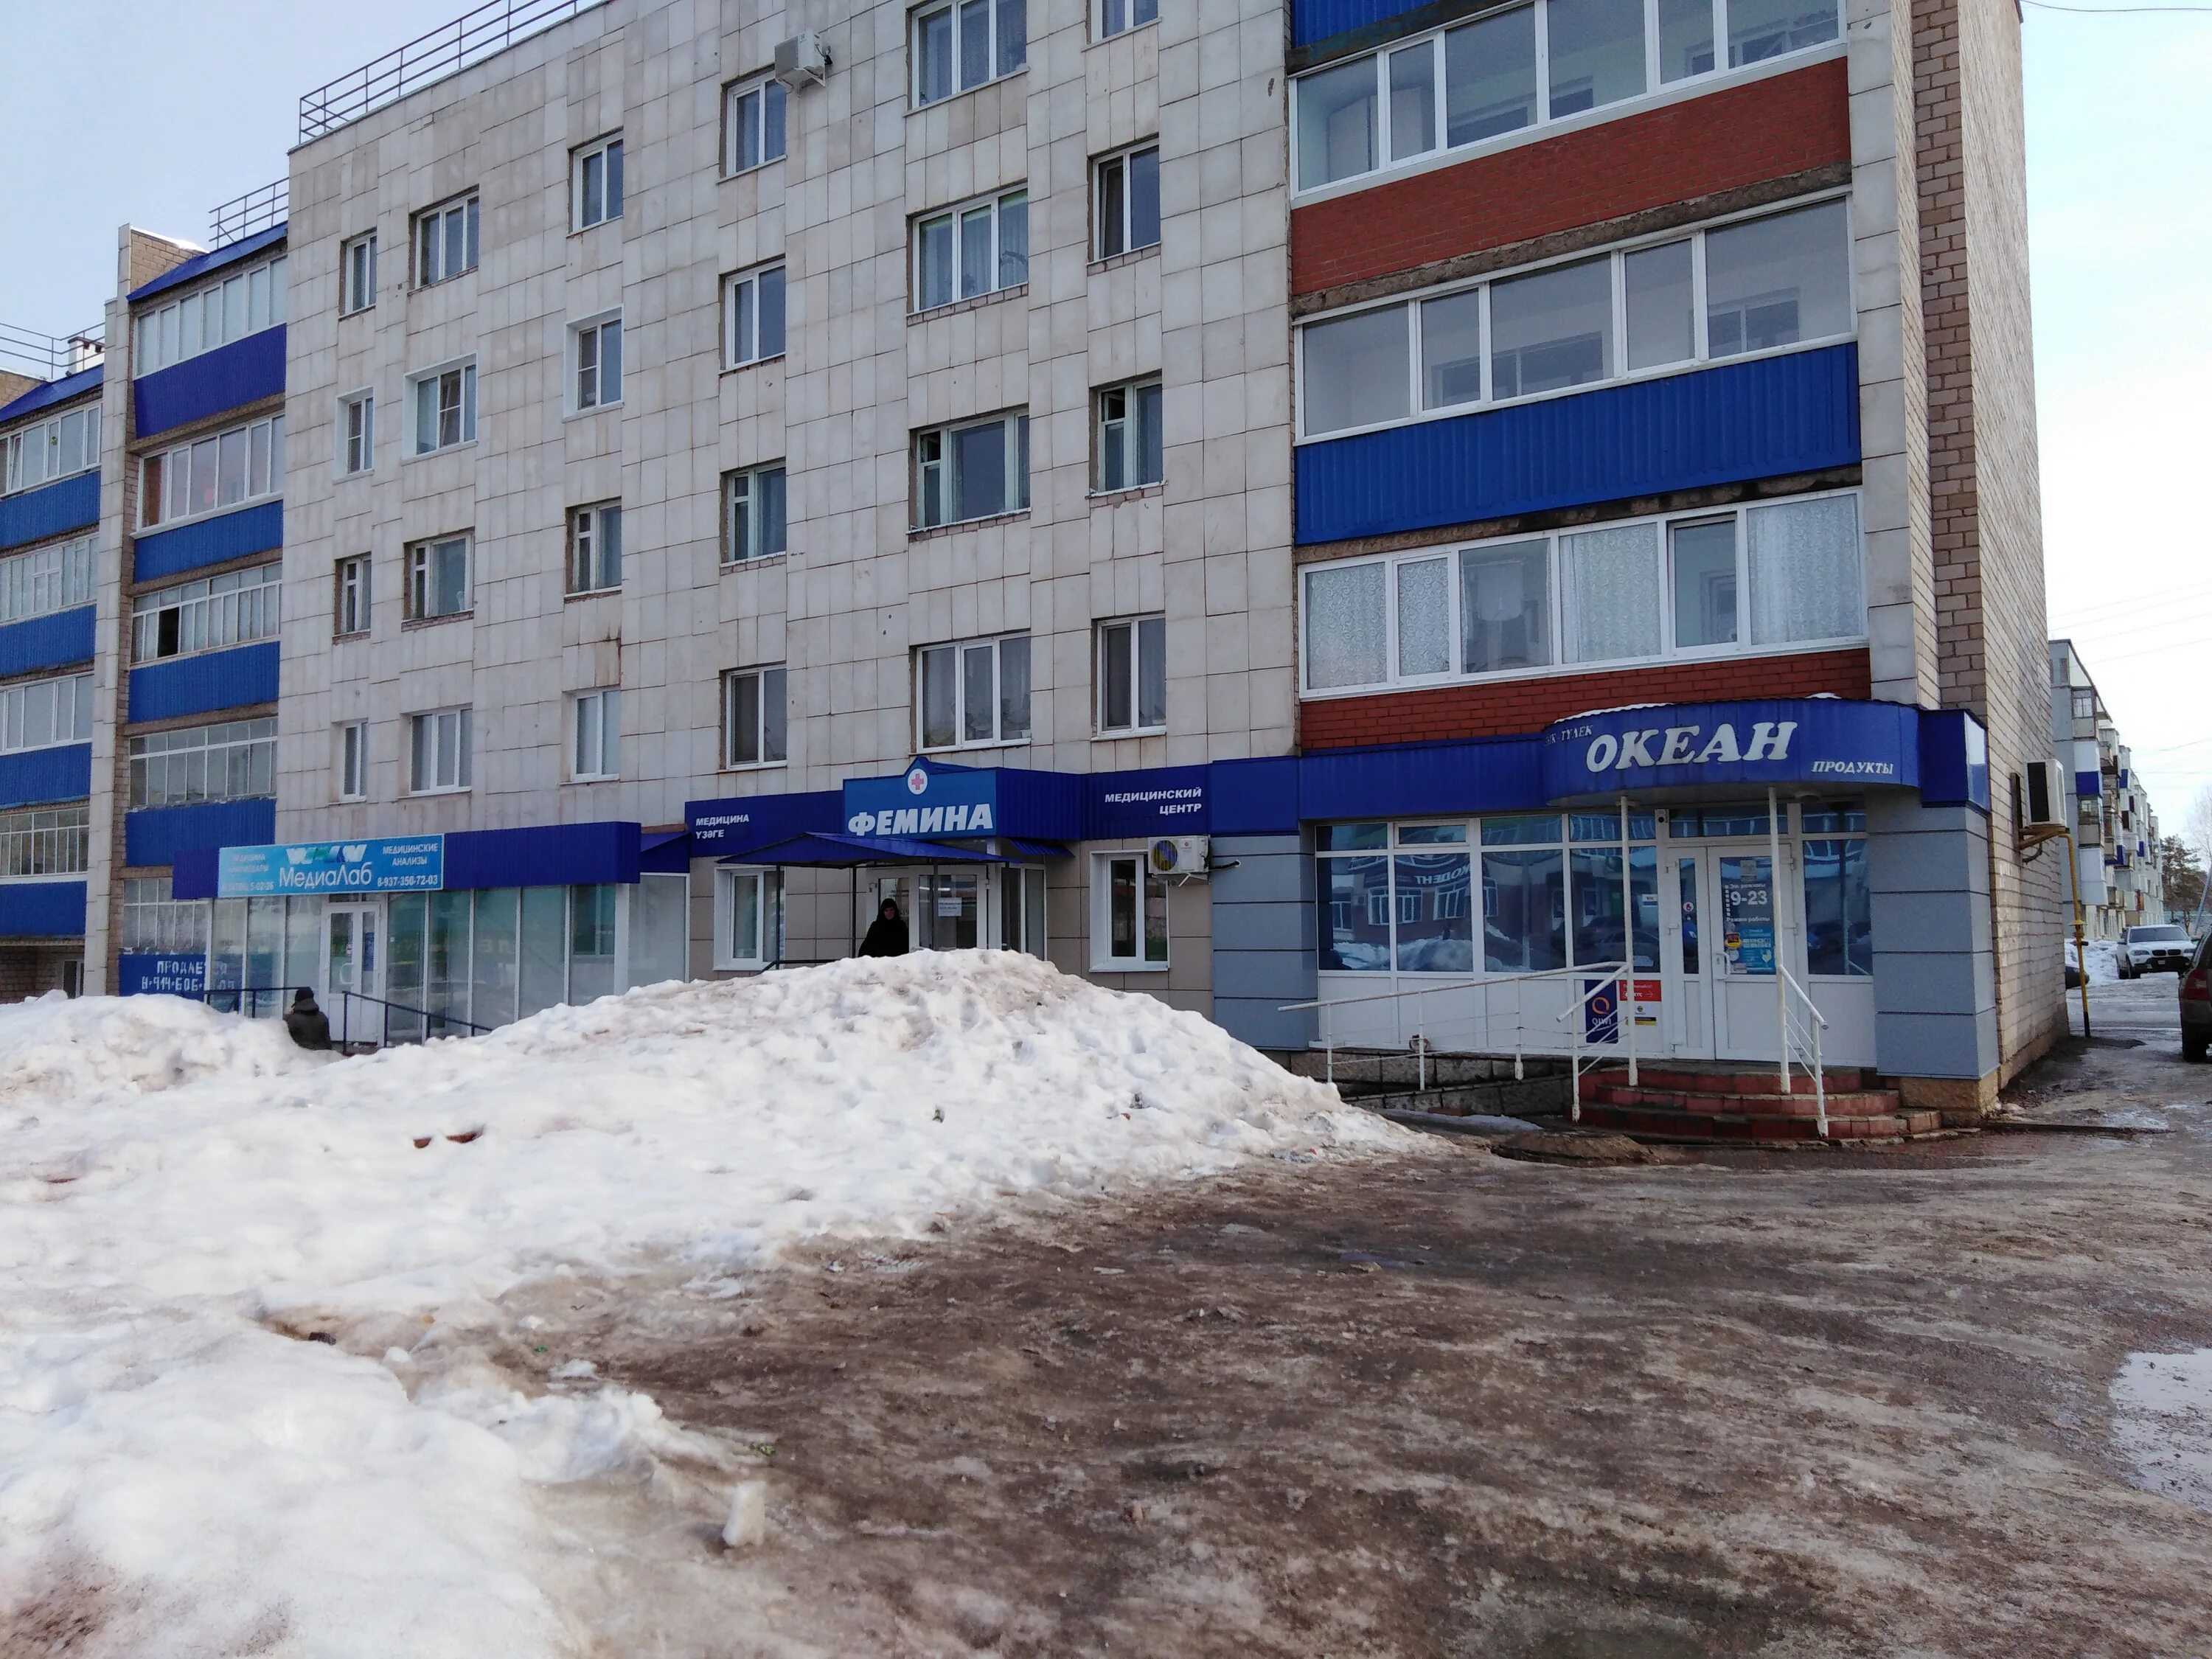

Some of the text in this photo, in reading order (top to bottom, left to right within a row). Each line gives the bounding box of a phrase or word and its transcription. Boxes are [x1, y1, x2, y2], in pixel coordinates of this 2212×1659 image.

[1586, 721, 1798, 773] ОКЕАН
[1811, 759, 1894, 776] ПРОДУКТЫ
[1104, 787, 1203, 804] МЕДИЦИНСКИЙ
[1159, 803, 1203, 816] ЦЕНТР
[695, 813, 750, 827] МЕДИЦИНА
[848, 803, 995, 837] ФЕМИНА
[383, 843, 438, 855] МЕДИЦИНСКИЕ
[392, 857, 428, 866] АНАЛИЗЫ
[279, 862, 373, 889] МедиаЛаб
[378, 874, 438, 888] 8-937-350-72-03
[1731, 890, 1768, 906] 9-23
